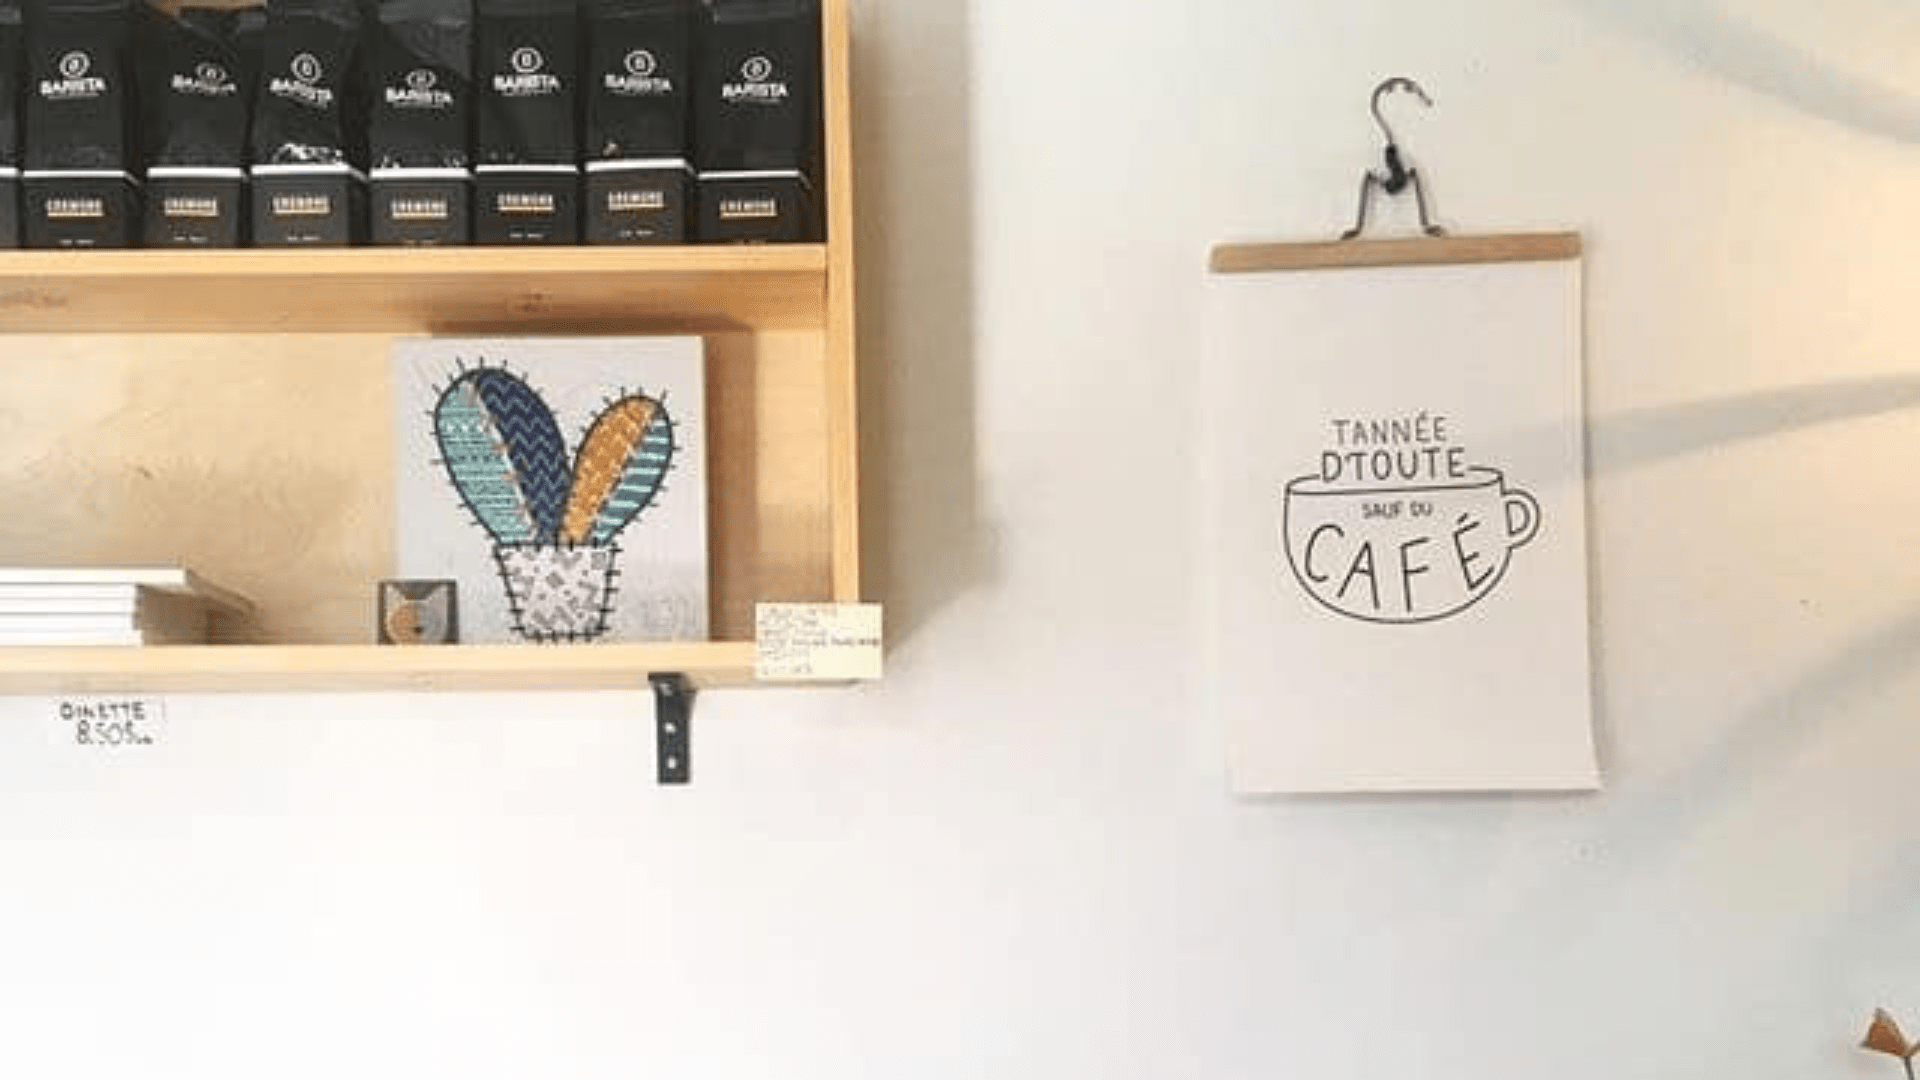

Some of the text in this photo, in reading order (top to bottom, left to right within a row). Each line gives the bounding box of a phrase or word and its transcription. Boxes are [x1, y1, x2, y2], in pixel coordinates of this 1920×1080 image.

[1331, 411, 1448, 446] TANNÉE
[1361, 502, 1434, 519] SAUF DU
[1304, 513, 1495, 612] CAFÉ
